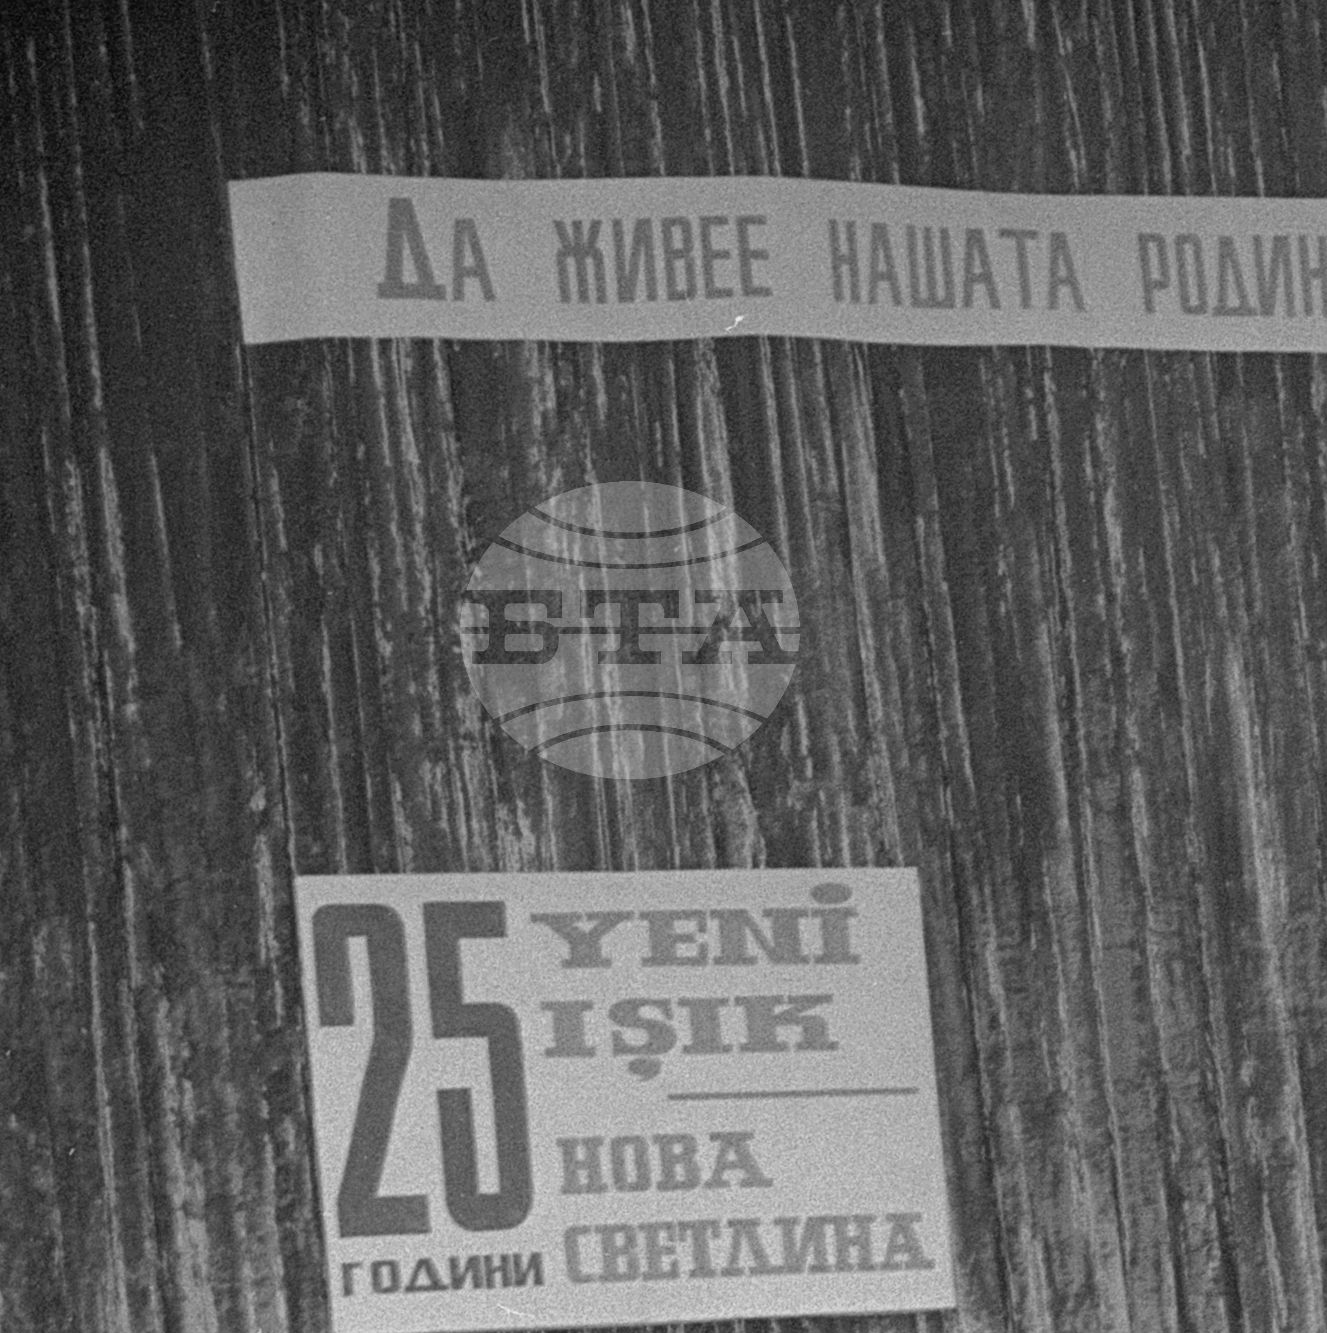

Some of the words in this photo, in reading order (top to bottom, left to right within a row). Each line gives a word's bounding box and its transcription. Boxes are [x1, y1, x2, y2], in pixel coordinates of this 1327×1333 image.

[377, 197, 497, 301] ДА
[554, 214, 773, 305] ЖИВЕЕ
[827, 219, 1087, 314] НАШАТА
[312, 899, 534, 1238] 25
[540, 993, 840, 1081] IŞIK
[556, 1131, 774, 1195] НОВА
[341, 1251, 545, 1297] ГОДИНИ
[563, 1211, 936, 1284] СВЕТЛИНА
